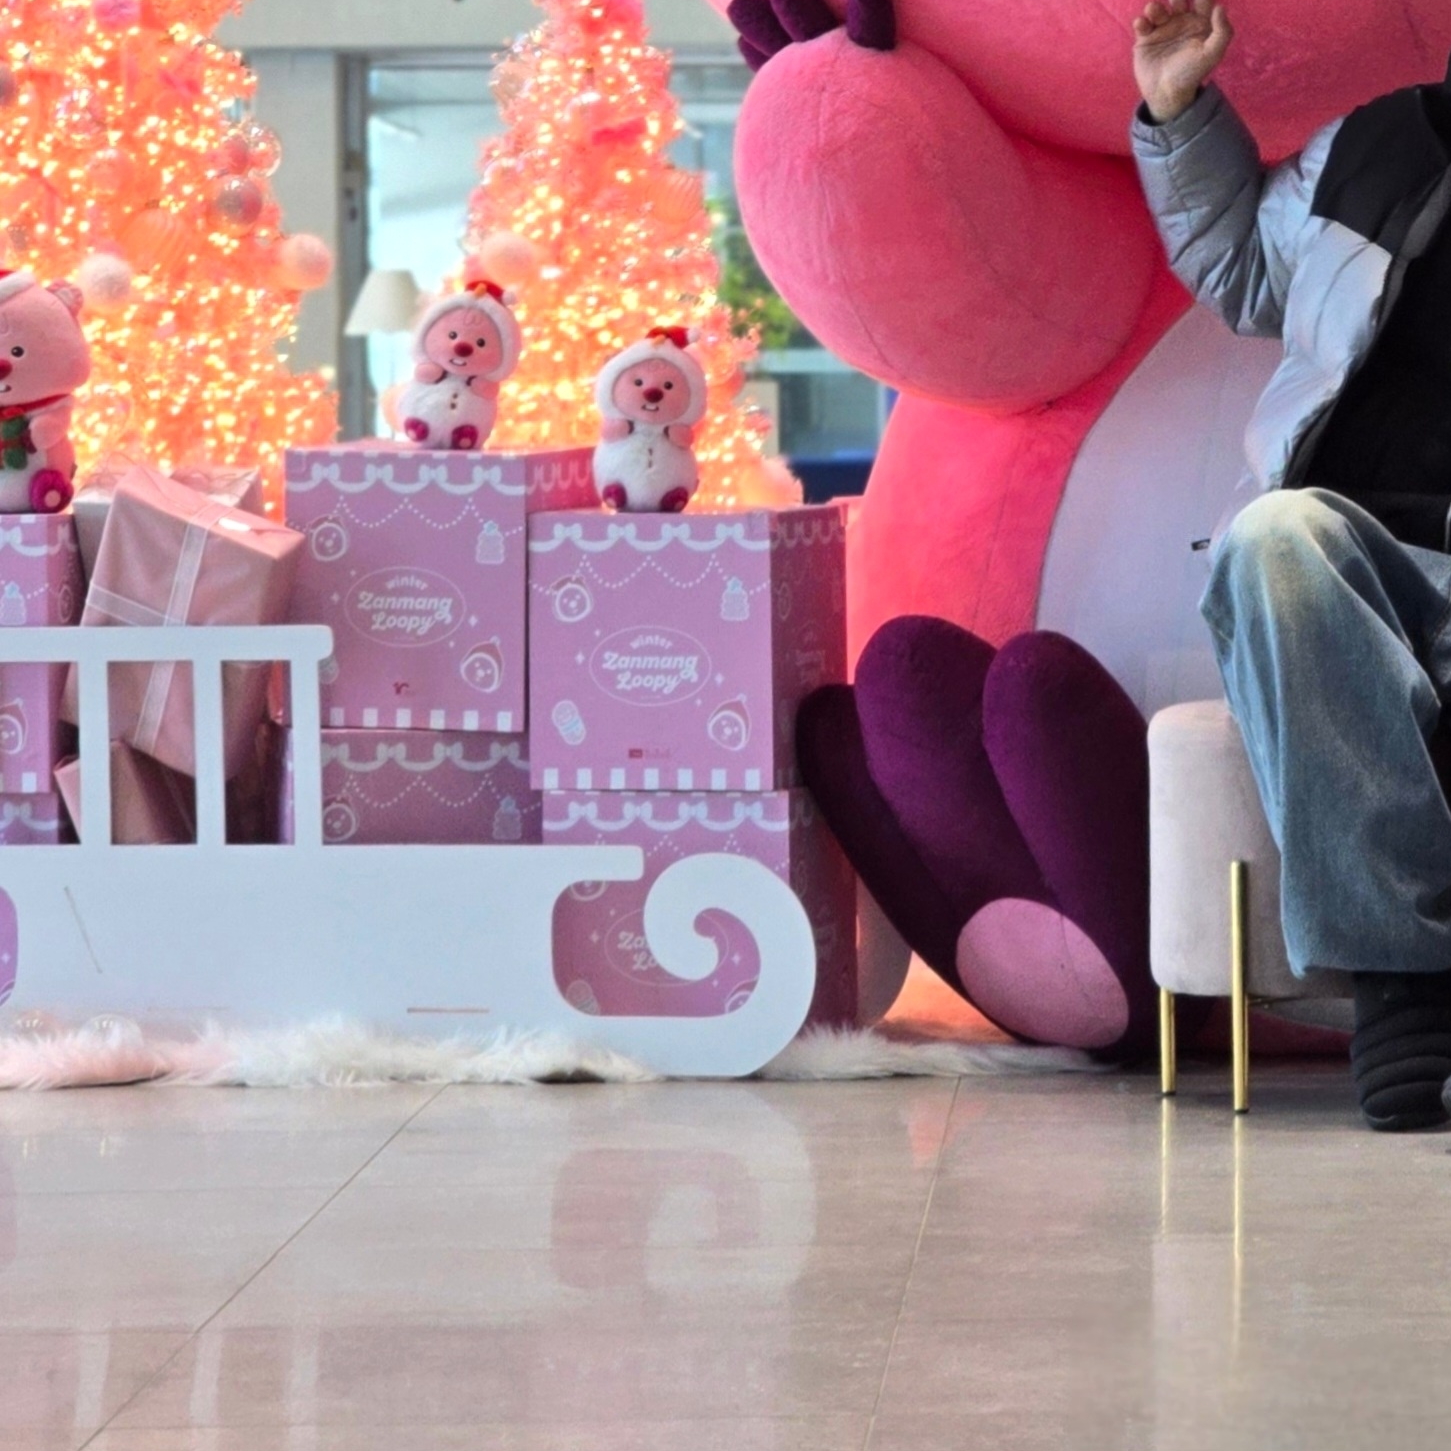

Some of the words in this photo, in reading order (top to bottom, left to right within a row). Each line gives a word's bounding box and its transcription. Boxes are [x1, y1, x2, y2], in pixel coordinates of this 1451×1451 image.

[386, 576, 428, 590] winter
[358, 591, 453, 624] Zanmang
[371, 611, 433, 635] Loopy
[630, 635, 673, 649] winter
[602, 651, 698, 682] Zanmang
[616, 671, 679, 694] Loopy
